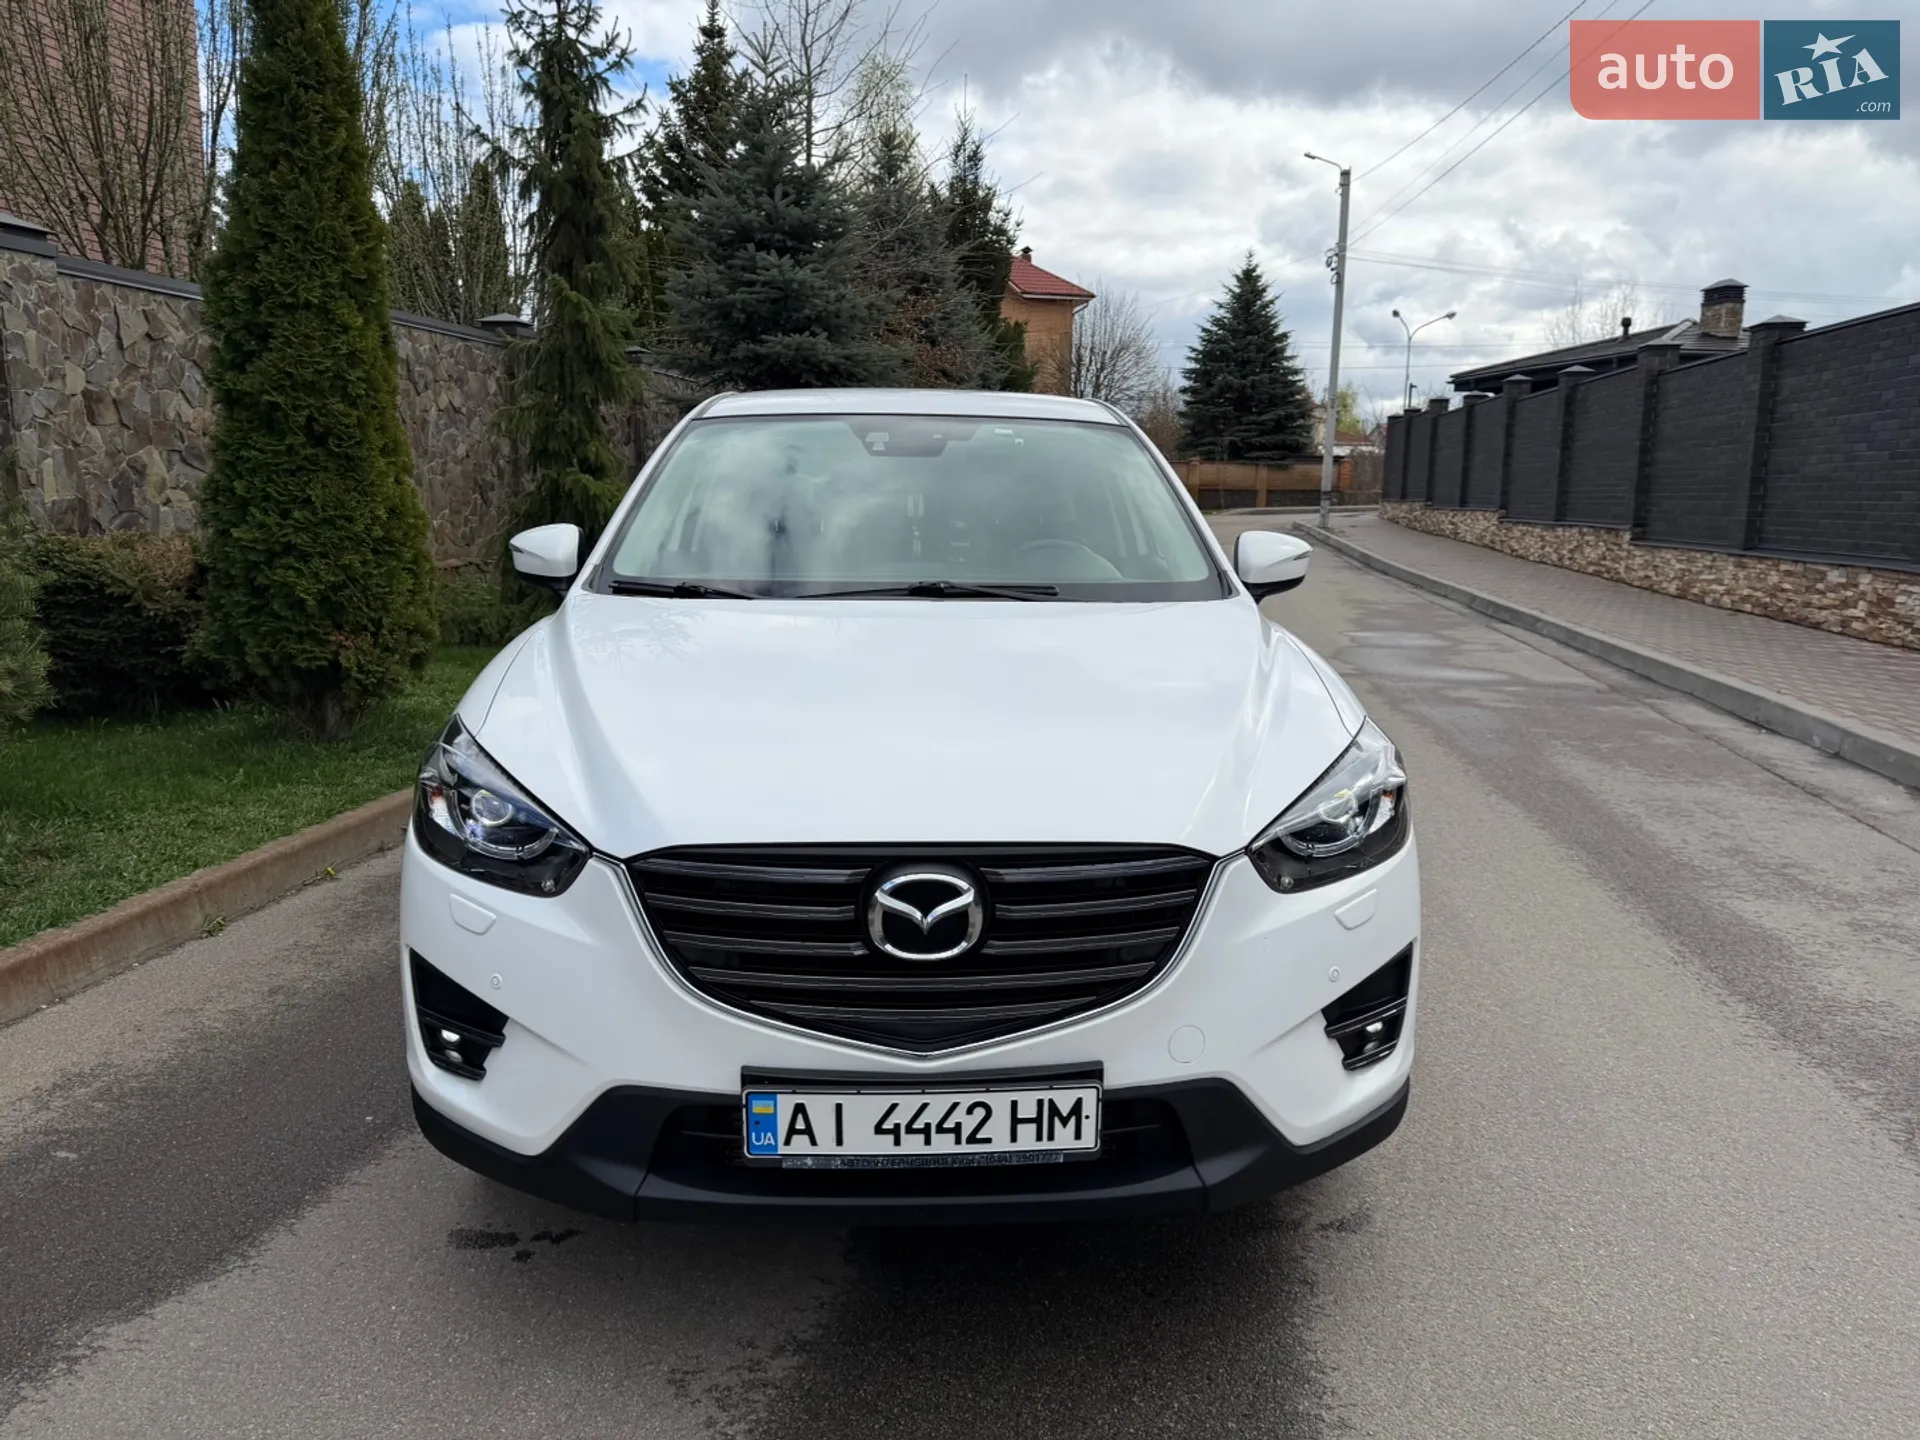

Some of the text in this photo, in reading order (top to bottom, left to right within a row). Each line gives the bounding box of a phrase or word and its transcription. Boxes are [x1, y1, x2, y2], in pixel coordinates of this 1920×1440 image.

[874, 1101, 993, 1146] 4442
[1010, 1098, 1083, 1143] HM
[752, 1132, 775, 1145] UA
